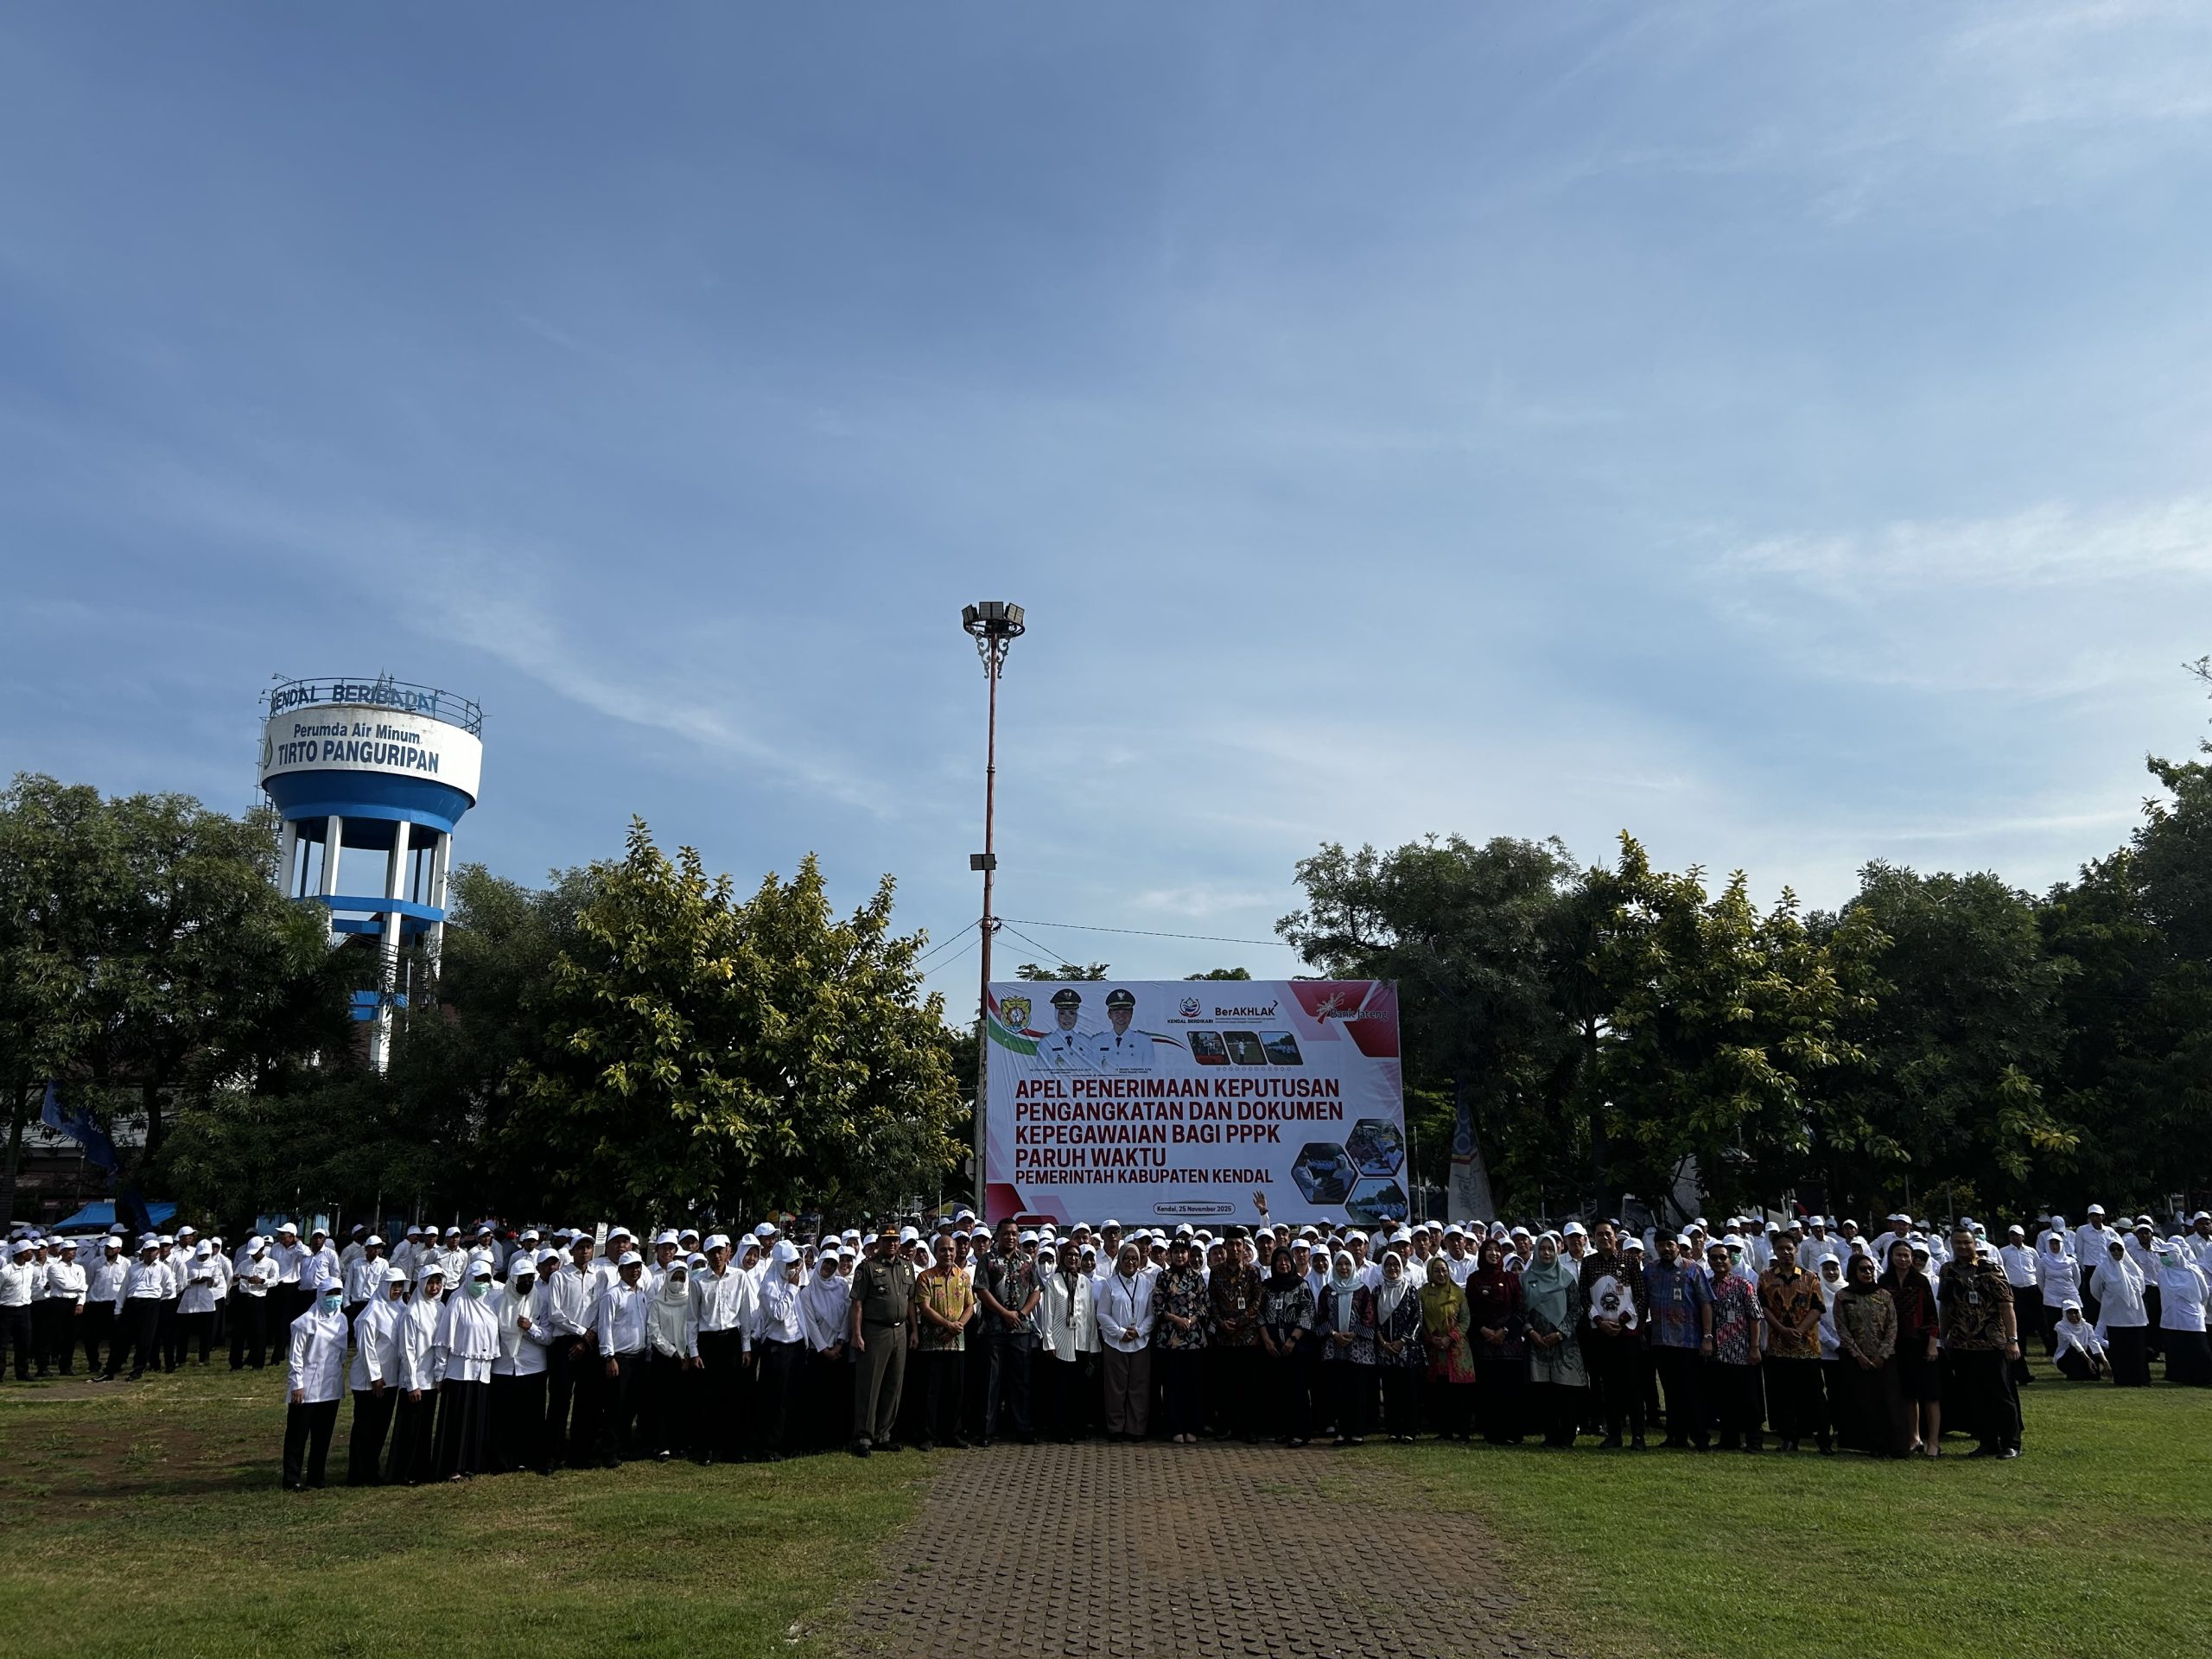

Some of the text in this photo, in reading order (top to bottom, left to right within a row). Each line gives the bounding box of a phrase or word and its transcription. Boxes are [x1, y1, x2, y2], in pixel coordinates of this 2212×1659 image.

[332, 685, 439, 712] BERIBADAT
[294, 722, 420, 744] Perumda Air Minum
[278, 741, 439, 773] TIRTO PANGURIPAN
[1215, 1007, 1275, 1016] BerAKHLAK
[1331, 1008, 1388, 1021] Bank Jateng
[1015, 1078, 1339, 1098] APEL PENERIMAAN KEPUTUSAN
[1015, 1102, 1343, 1122] PENGANGKATAN DAN DOKUMEN
[1015, 1124, 1281, 1144] KEPEGAWAIAN BAGI PPPK
[1015, 1147, 1166, 1167] PARUH WAKTU
[1015, 1169, 1274, 1184] PEMERINTAH KABUPATEN KENDAL
